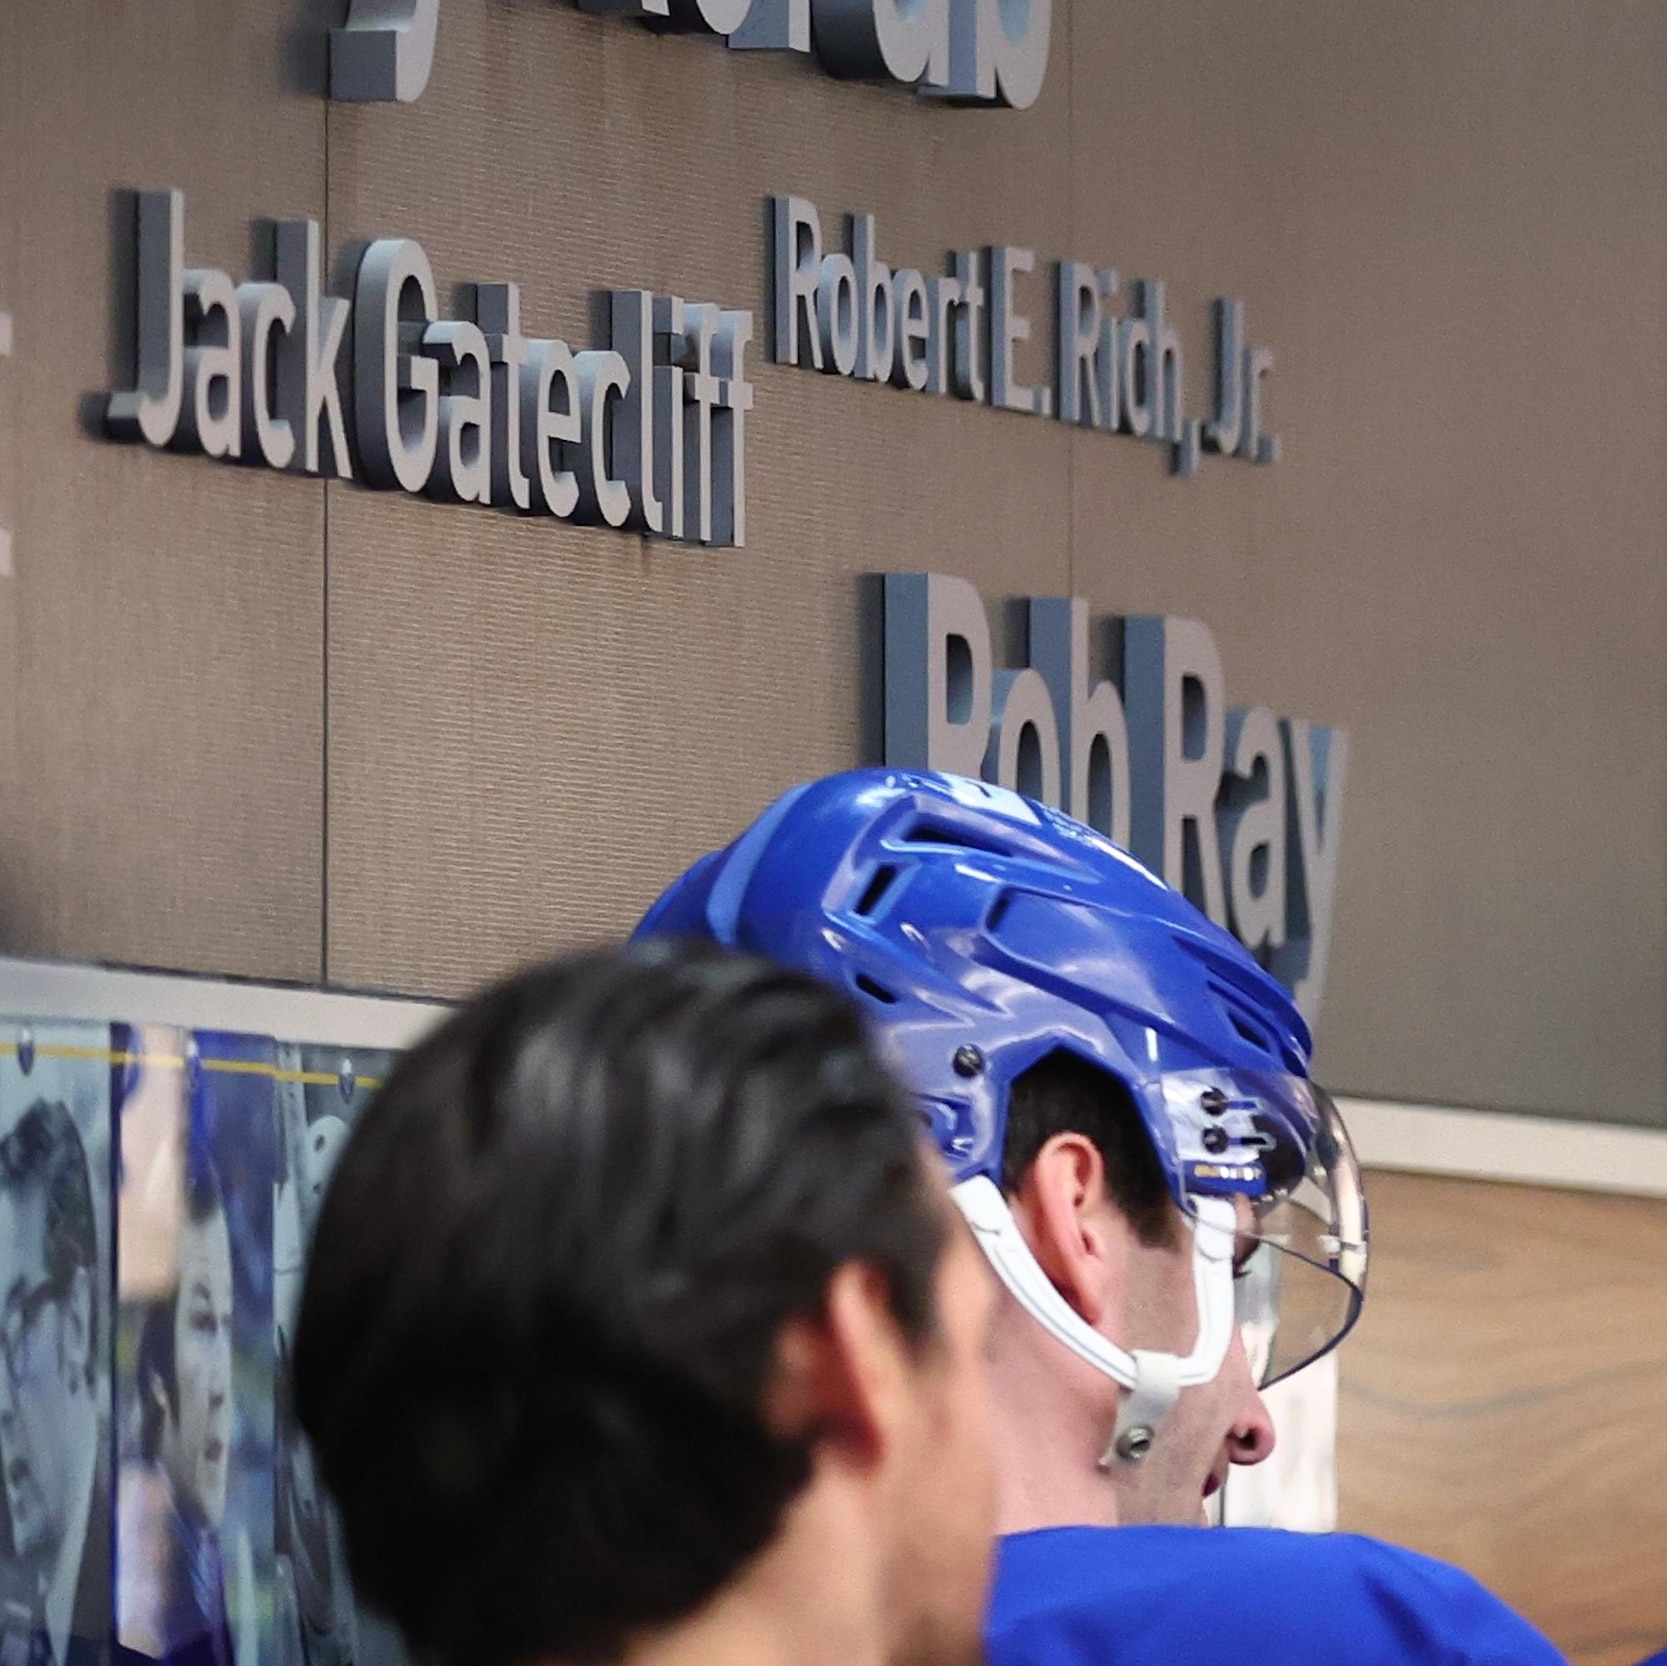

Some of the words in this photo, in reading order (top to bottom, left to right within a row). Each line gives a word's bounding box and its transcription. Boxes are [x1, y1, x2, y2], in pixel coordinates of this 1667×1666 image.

[108, 188, 353, 480] Jack
[355, 238, 754, 547] Gatecliff
[774, 195, 985, 401] Robert
[989, 245, 1051, 416] E.
[1058, 260, 1200, 479] Rich,
[1203, 299, 1279, 463] Jr.
[1123, 615, 1348, 1025] Ray
